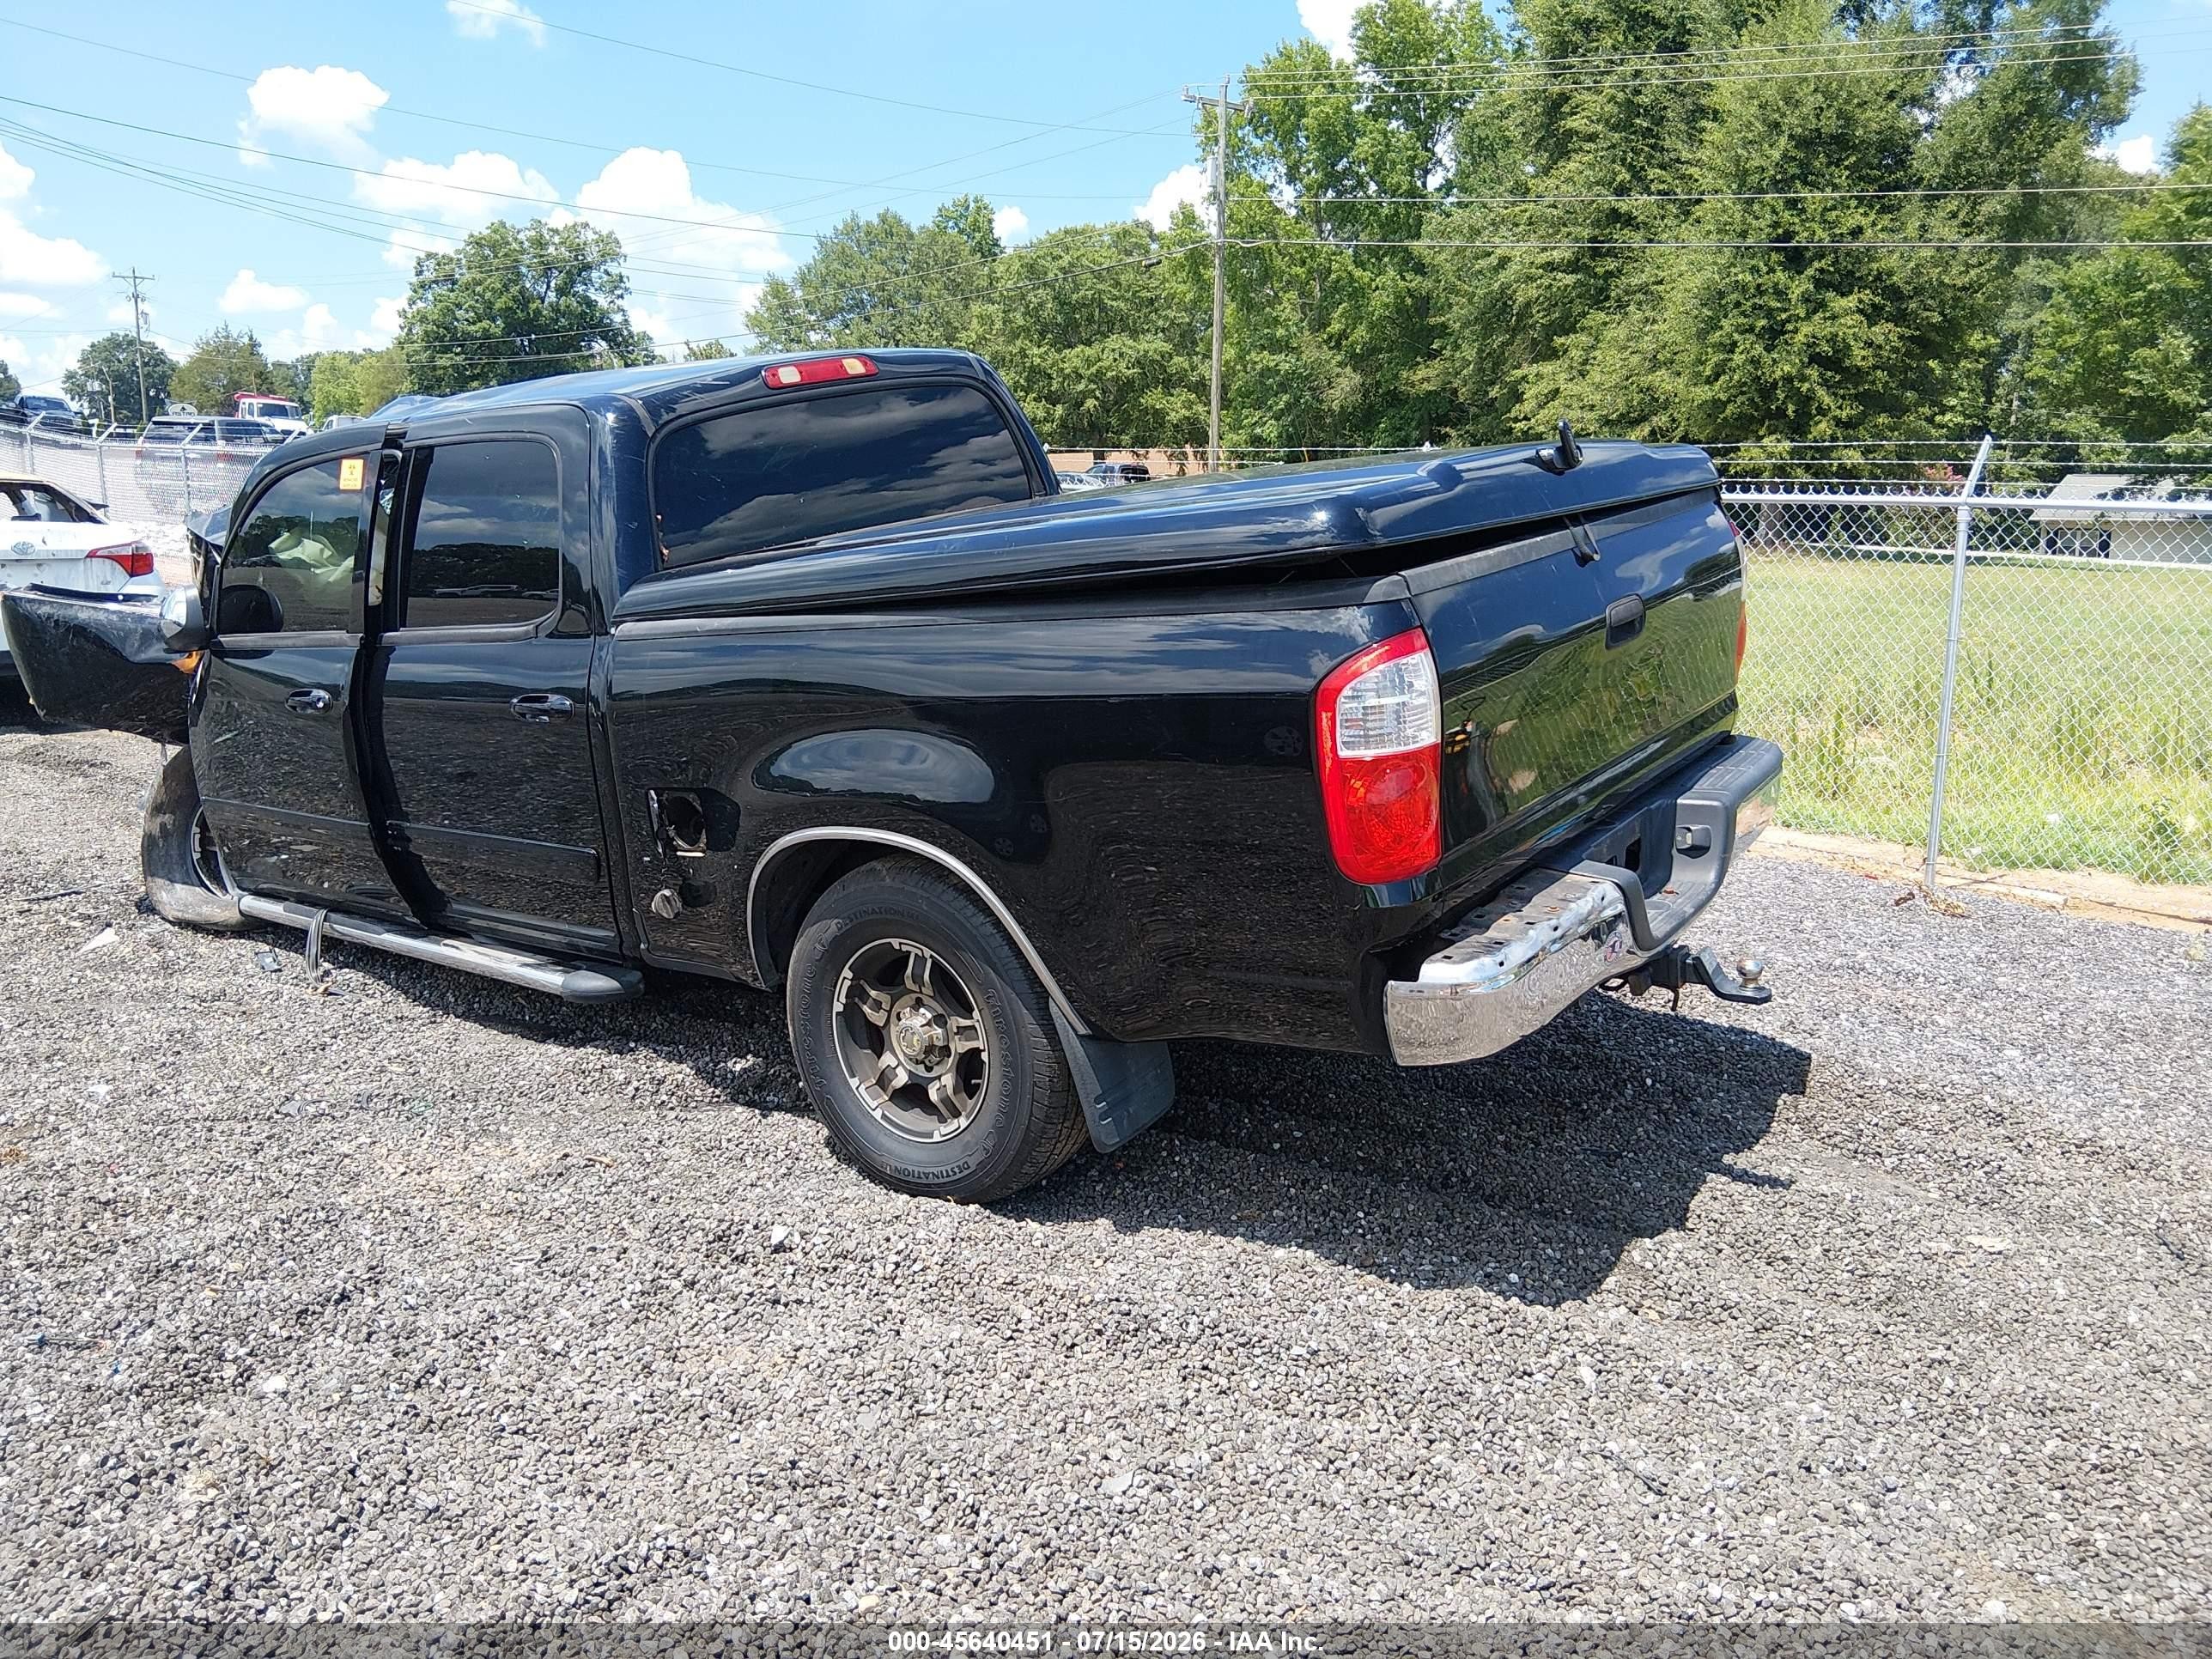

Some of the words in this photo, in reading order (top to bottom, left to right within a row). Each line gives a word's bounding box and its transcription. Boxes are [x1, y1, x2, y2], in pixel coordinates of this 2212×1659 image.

[798, 963, 827, 1091] Firestone
[984, 988, 1015, 1128] Firestone
[894, 1160, 971, 1181] DESTINATION
